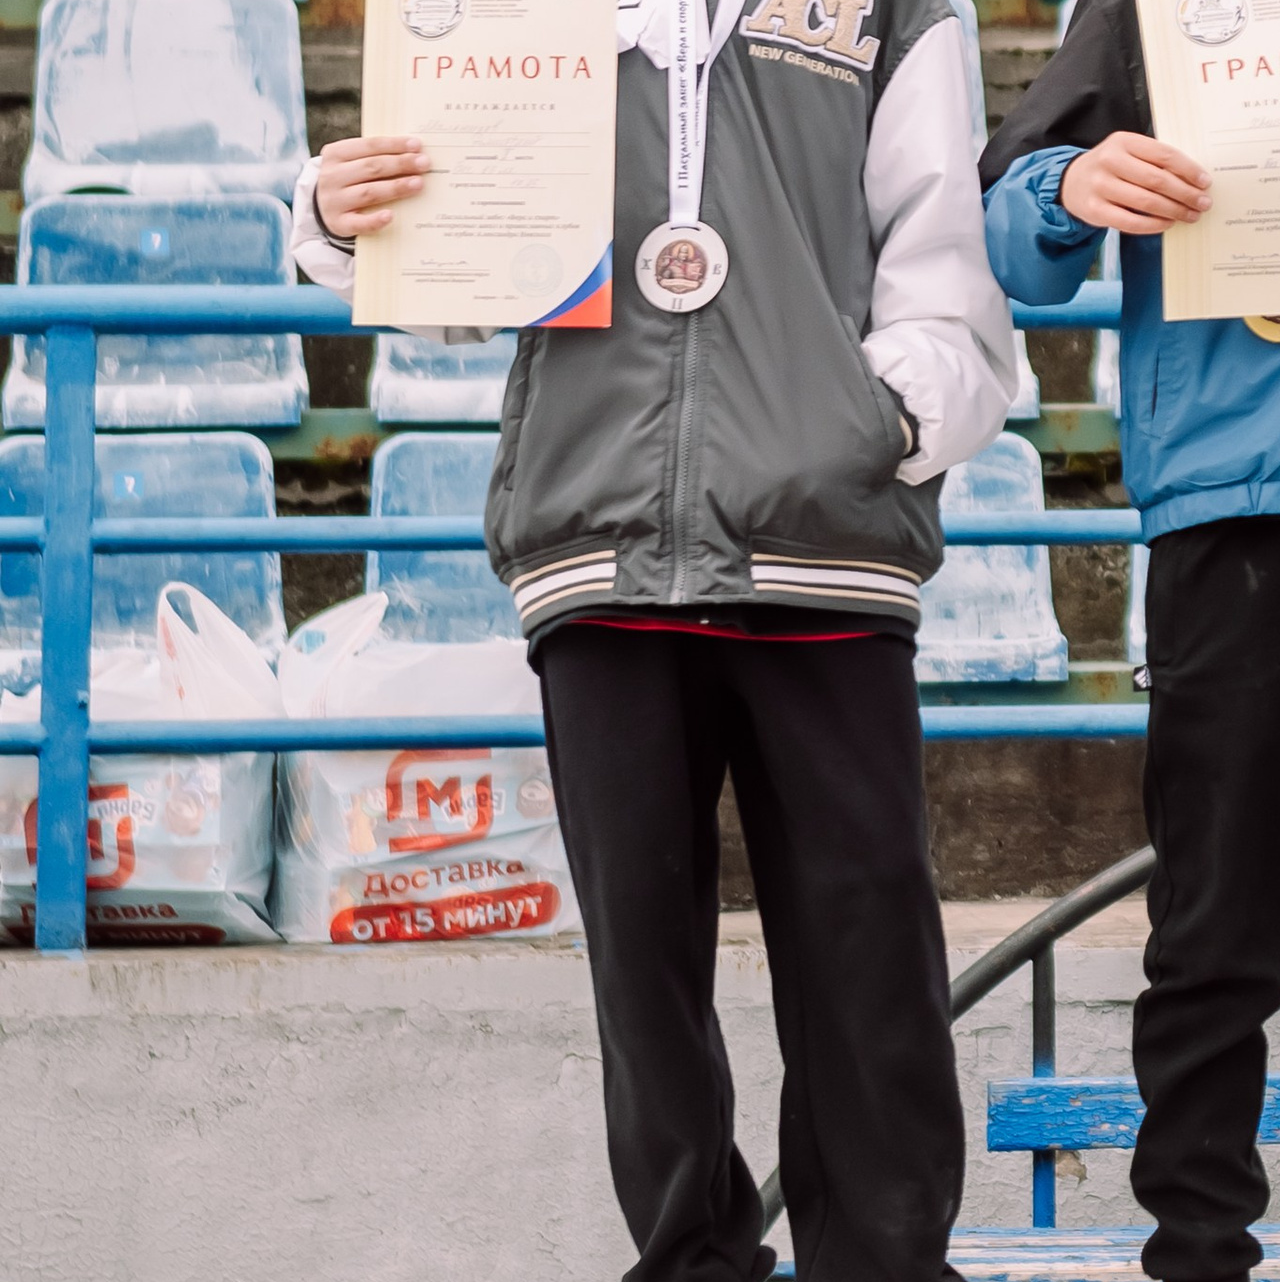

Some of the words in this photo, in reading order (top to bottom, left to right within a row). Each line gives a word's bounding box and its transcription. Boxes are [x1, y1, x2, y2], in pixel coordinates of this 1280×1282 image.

[412, 56, 592, 79] ГРАМОТА
[749, 44, 782, 65] NEW
[784, 50, 860, 87] GENERATION
[444, 103, 556, 112] НАГРАЖДАЕТСЯ
[677, 111, 692, 180] Пасхальный
[364, 858, 525, 898] Доставка
[352, 915, 390, 940] от
[399, 909, 435, 934] 15
[443, 895, 542, 931] минут
